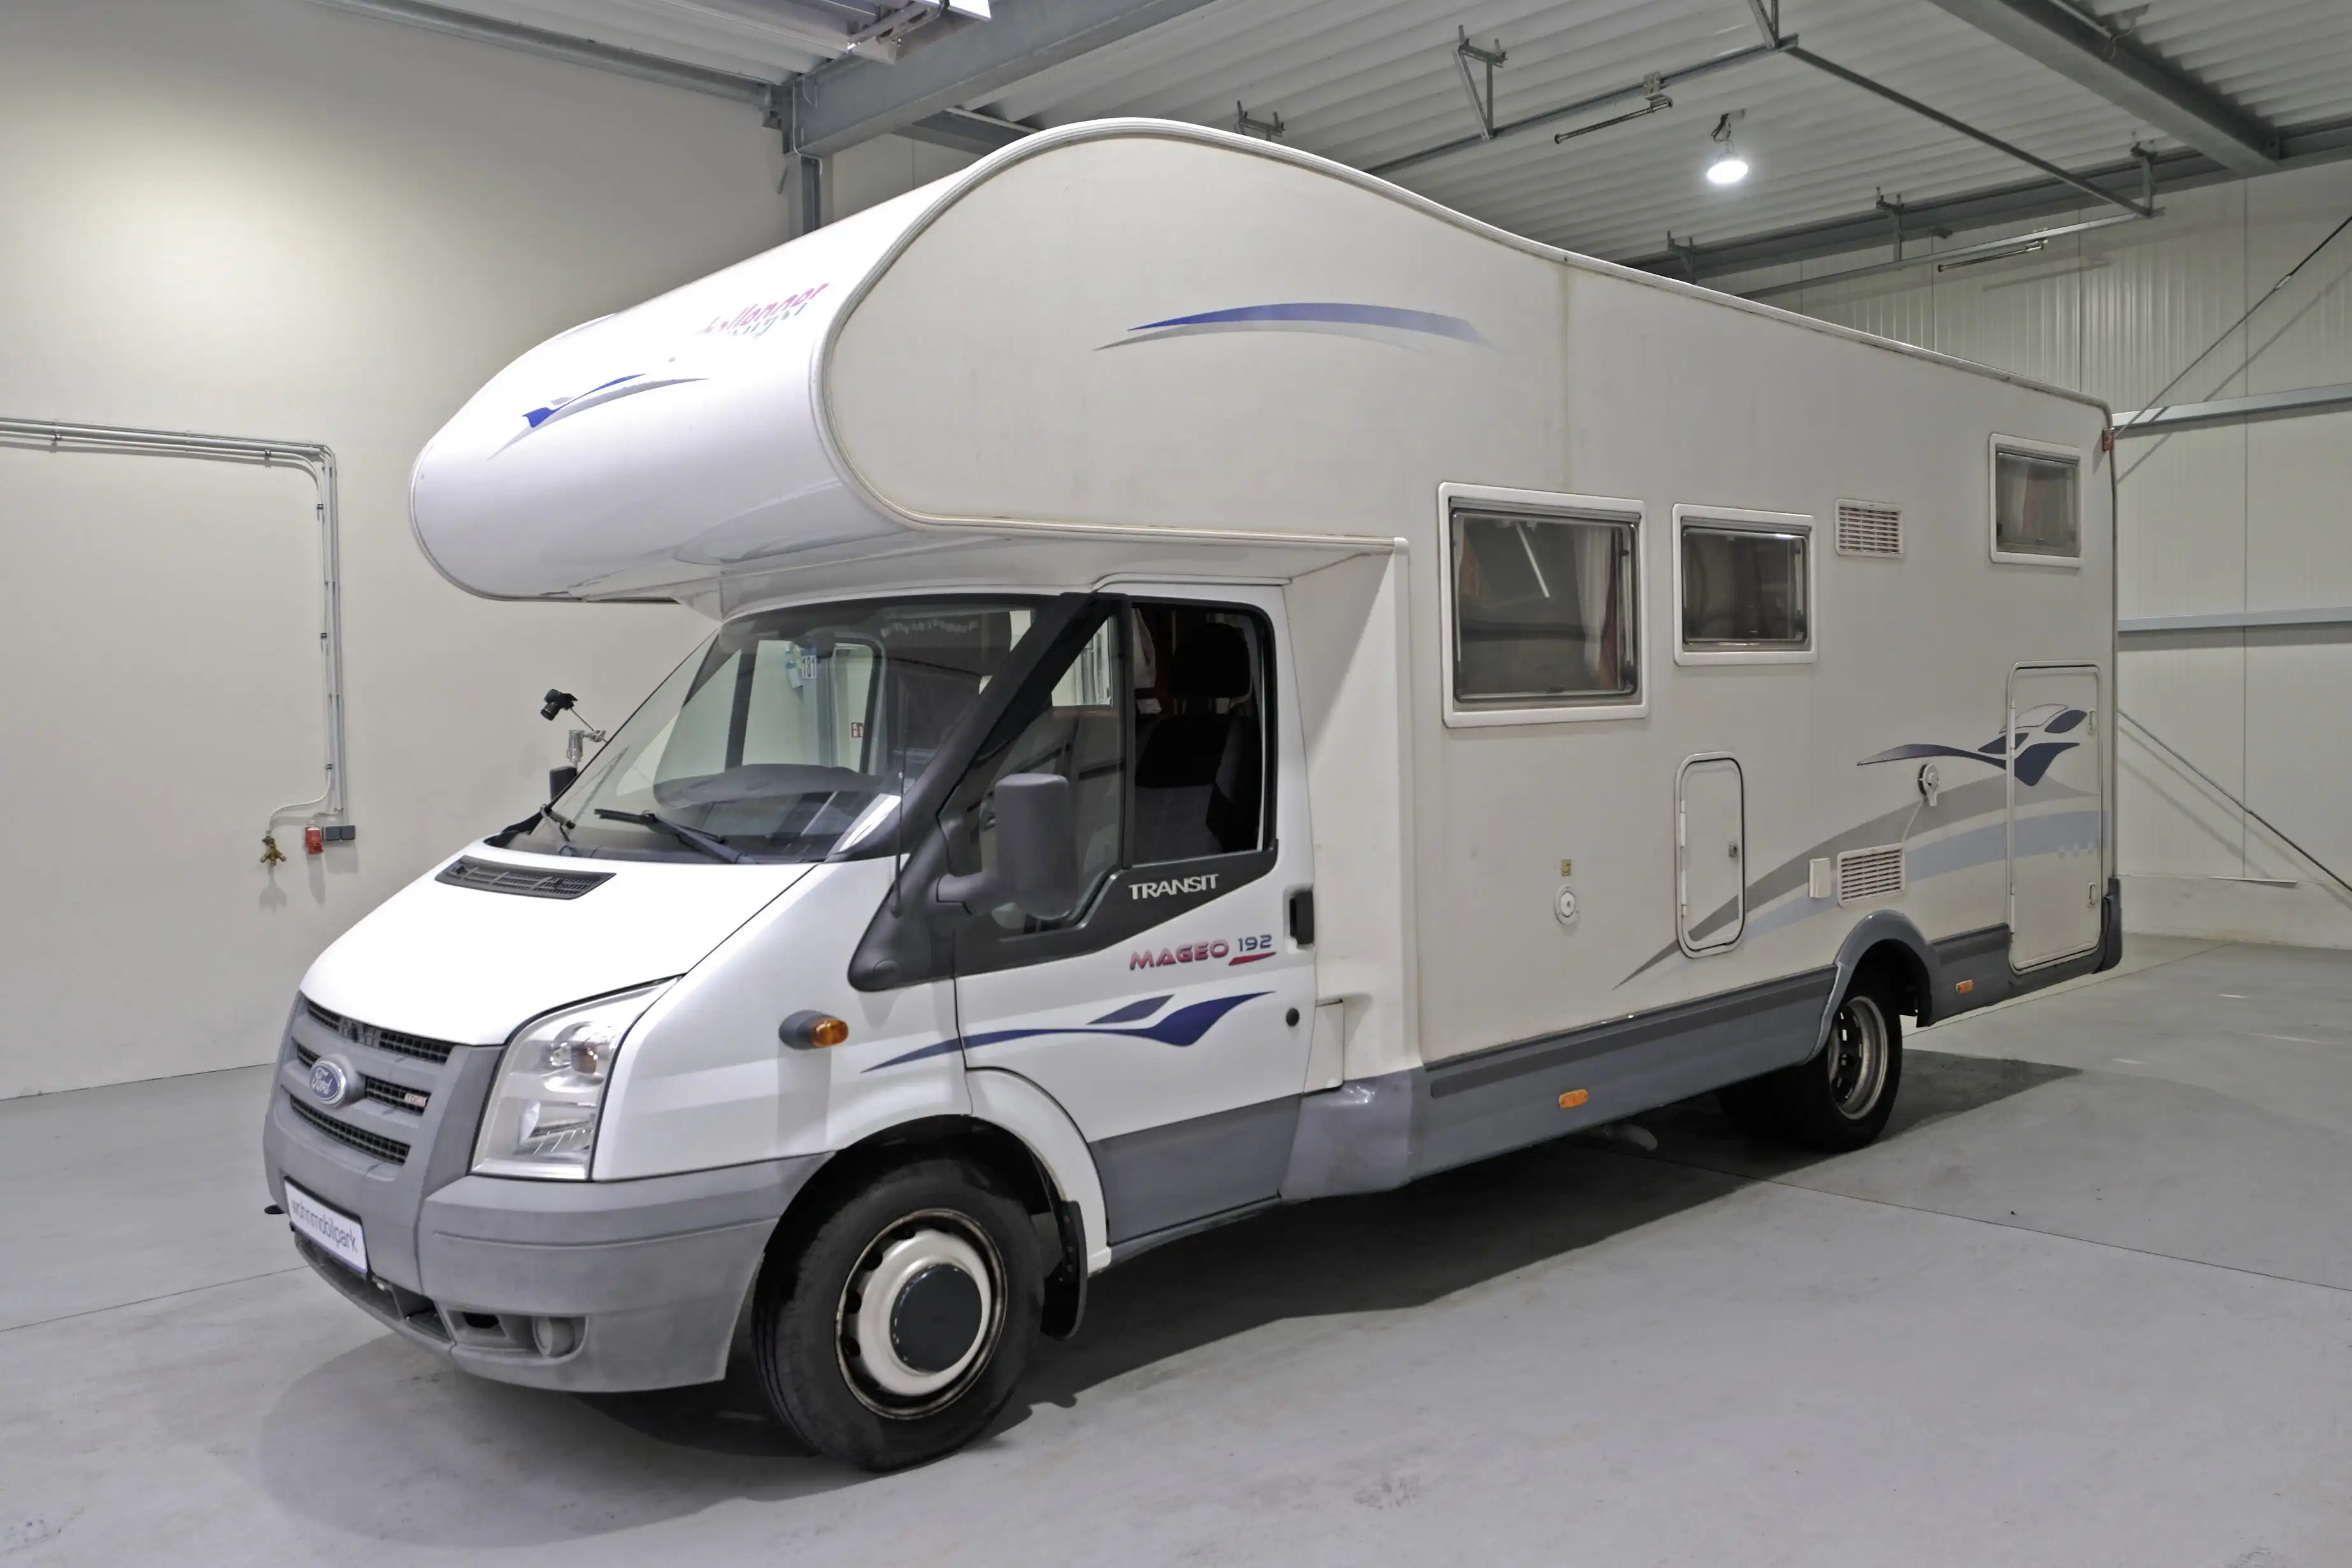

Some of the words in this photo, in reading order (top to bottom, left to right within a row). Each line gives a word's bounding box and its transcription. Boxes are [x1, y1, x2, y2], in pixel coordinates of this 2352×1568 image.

[1129, 874, 1219, 900] TRANSIT
[1129, 939, 1230, 971] MAGEO
[1237, 934, 1272, 952] 192
[311, 1067, 333, 1095] Ford
